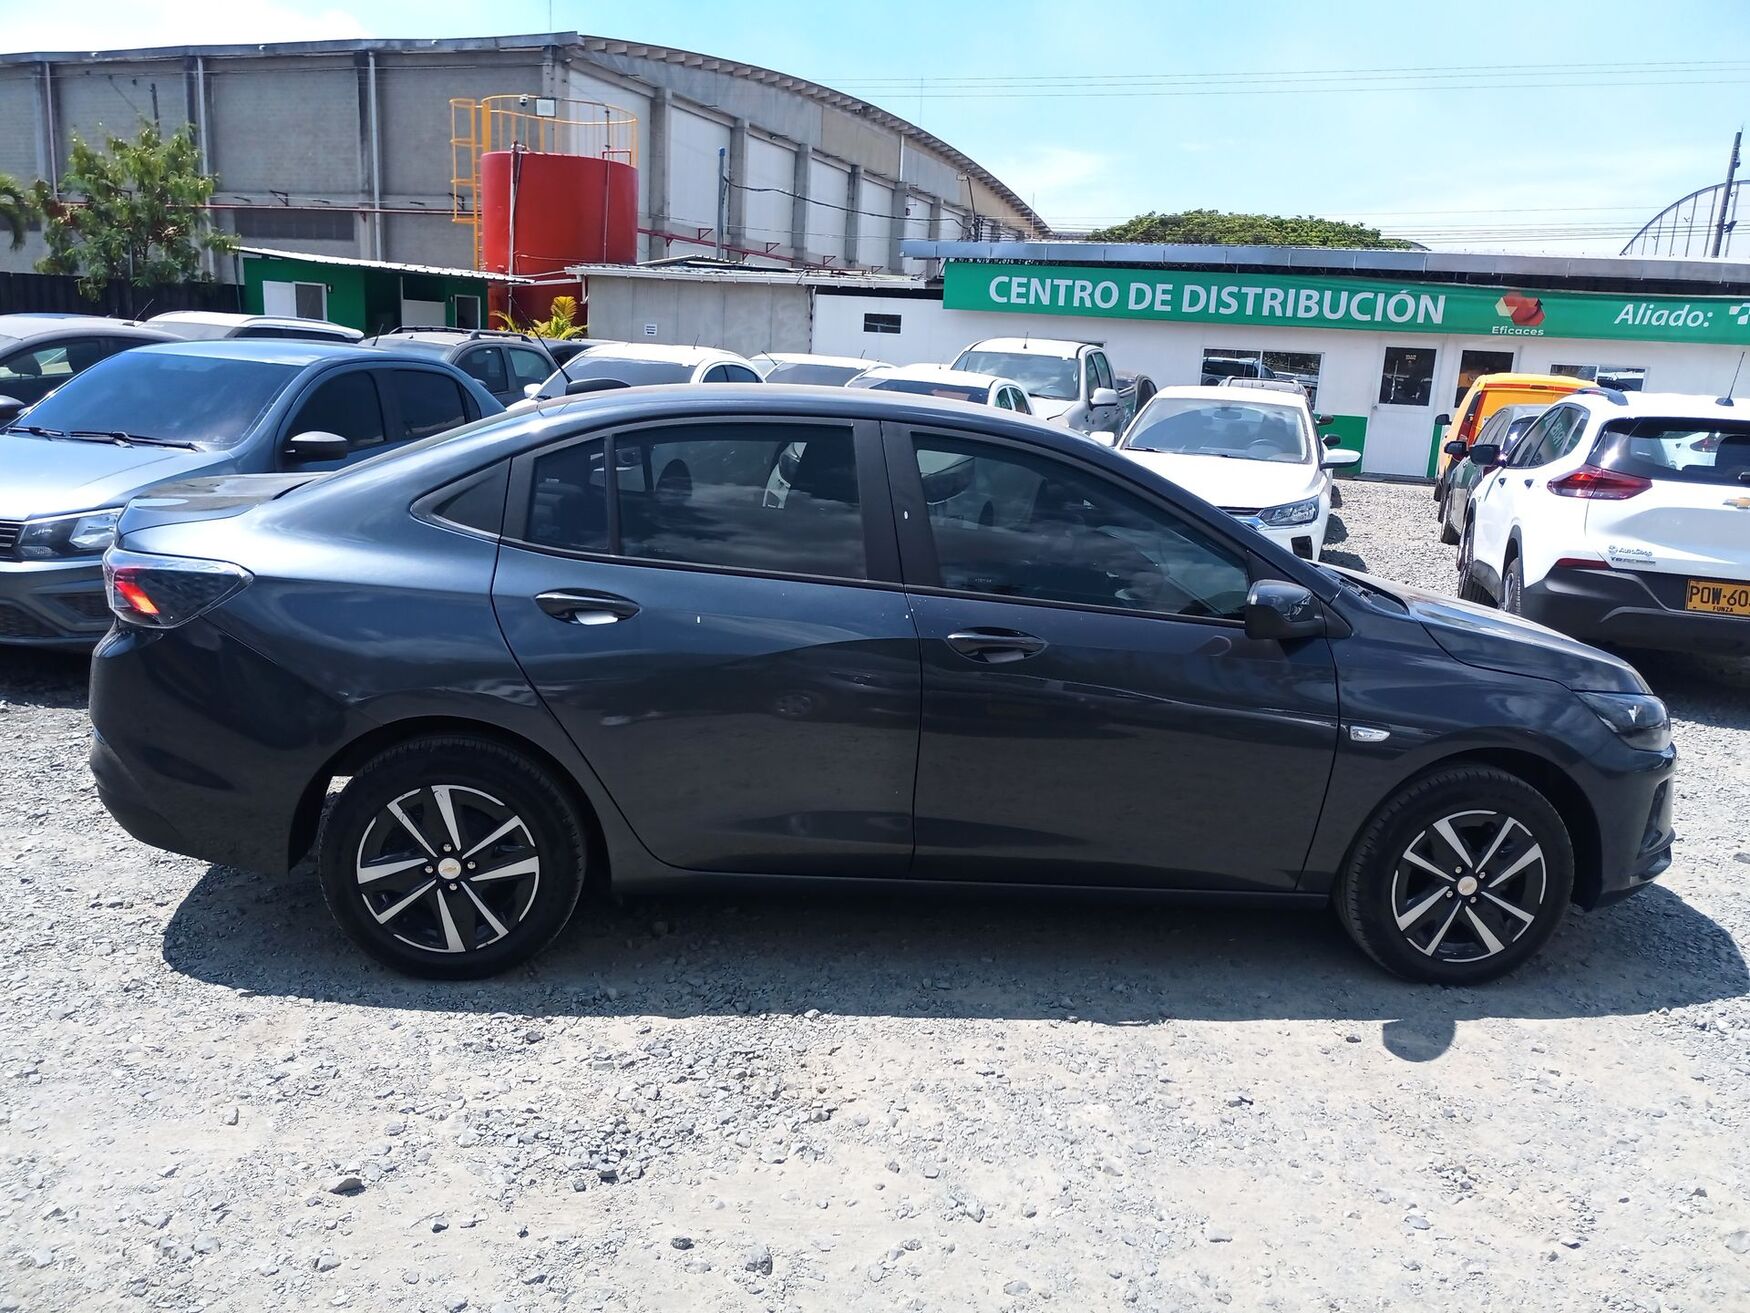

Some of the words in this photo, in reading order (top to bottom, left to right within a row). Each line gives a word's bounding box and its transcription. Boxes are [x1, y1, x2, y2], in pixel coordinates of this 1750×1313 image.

[989, 275, 1119, 309] CENTRO
[1128, 282, 1174, 312] DE
[1182, 285, 1446, 324] DISTRIBUCIÓN
[1614, 303, 1713, 327] Aliado:
[1491, 325, 1544, 336] Eficaces
[1712, 605, 1734, 613] FUNZA
